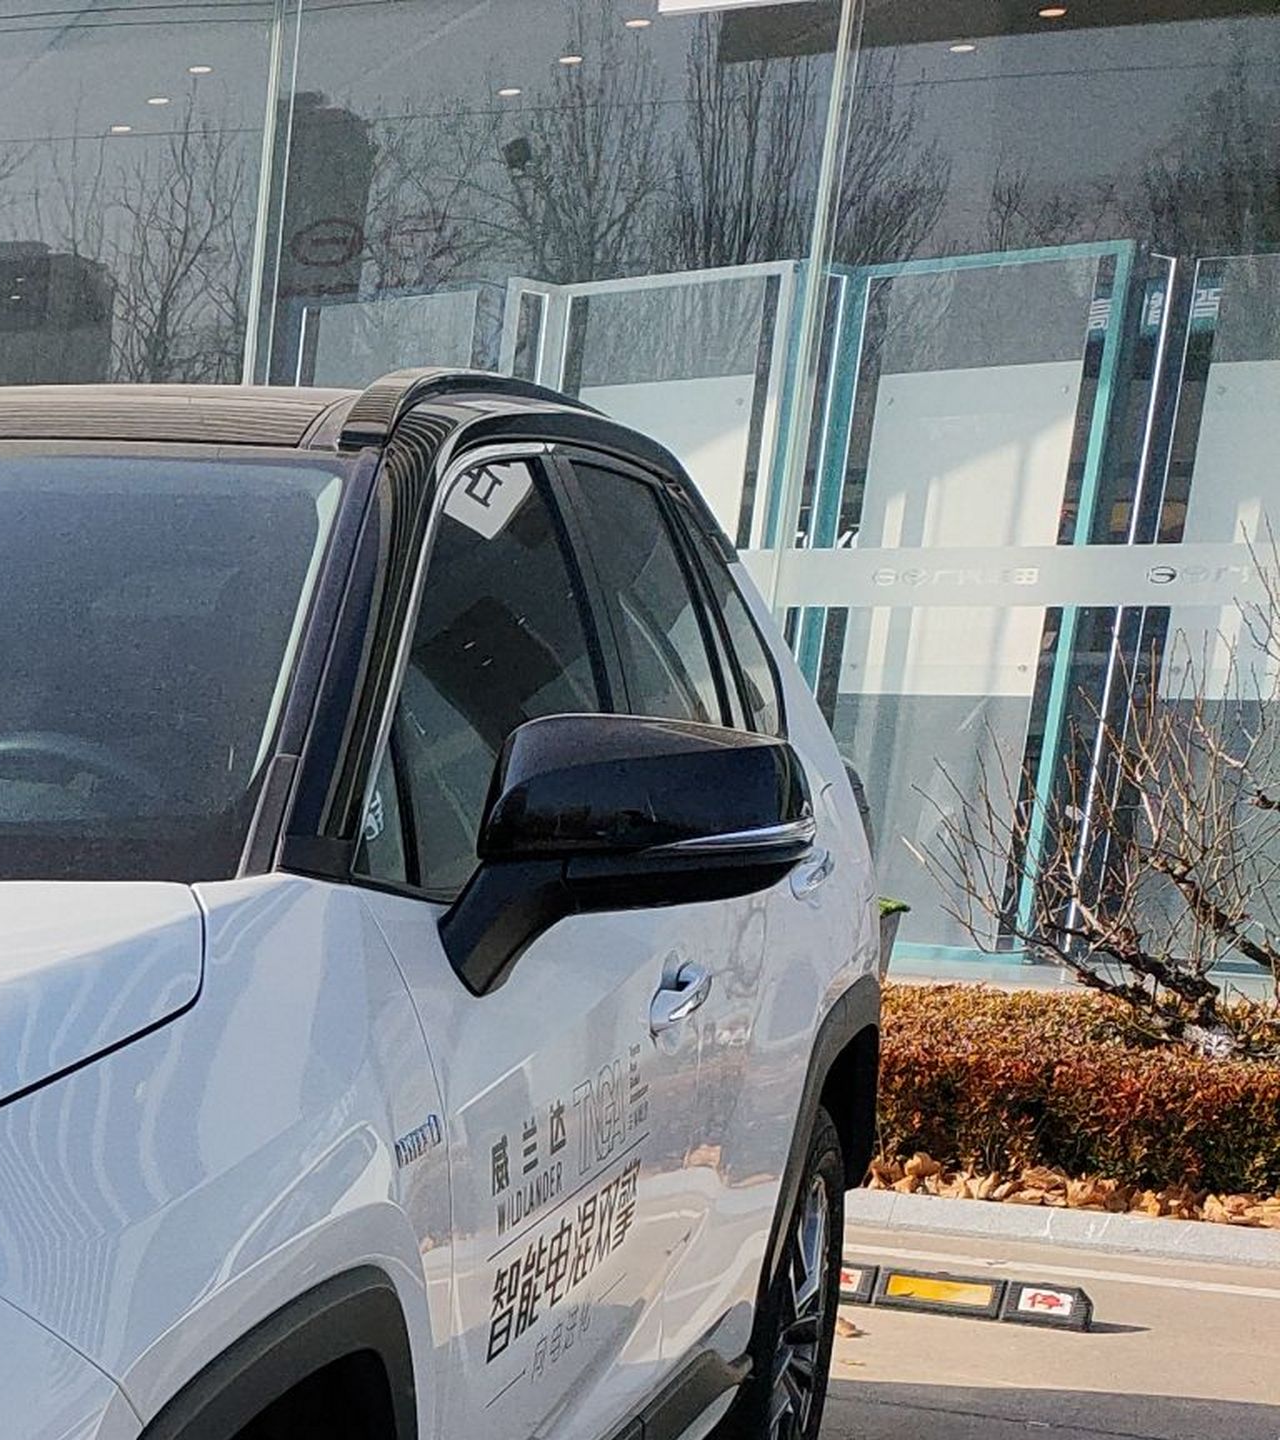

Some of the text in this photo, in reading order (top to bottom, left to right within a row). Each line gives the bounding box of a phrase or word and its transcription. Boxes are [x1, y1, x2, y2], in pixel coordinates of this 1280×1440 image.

[491, 1099, 567, 1196] 威兰达
[496, 1161, 563, 1237] WILDLANDER
